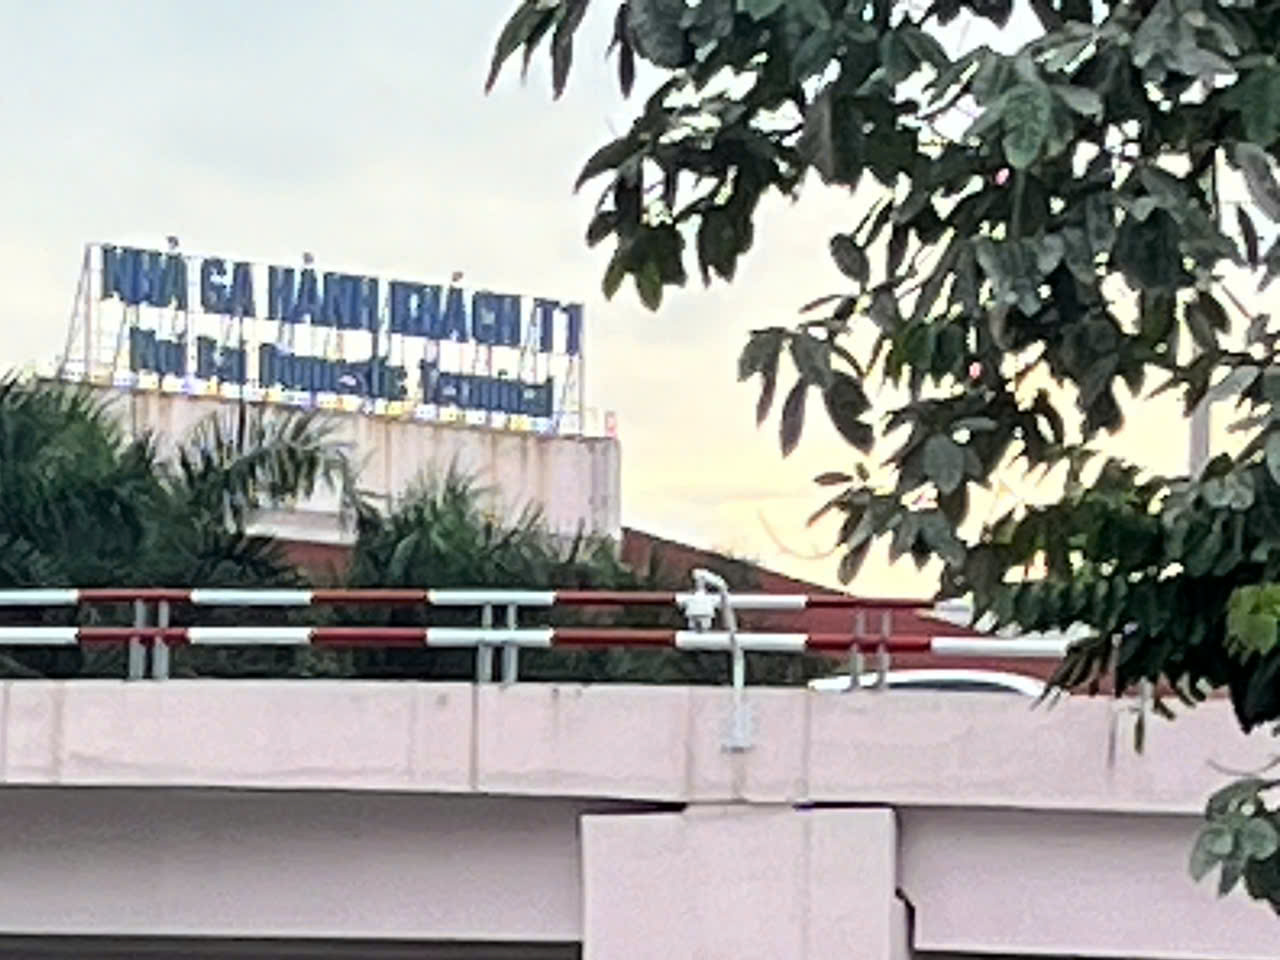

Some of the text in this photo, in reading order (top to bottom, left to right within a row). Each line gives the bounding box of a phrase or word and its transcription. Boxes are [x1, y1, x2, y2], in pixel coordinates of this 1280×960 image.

[201, 258, 256, 317] GA
[268, 252, 378, 333] HÀNH
[533, 298, 583, 357] T1
